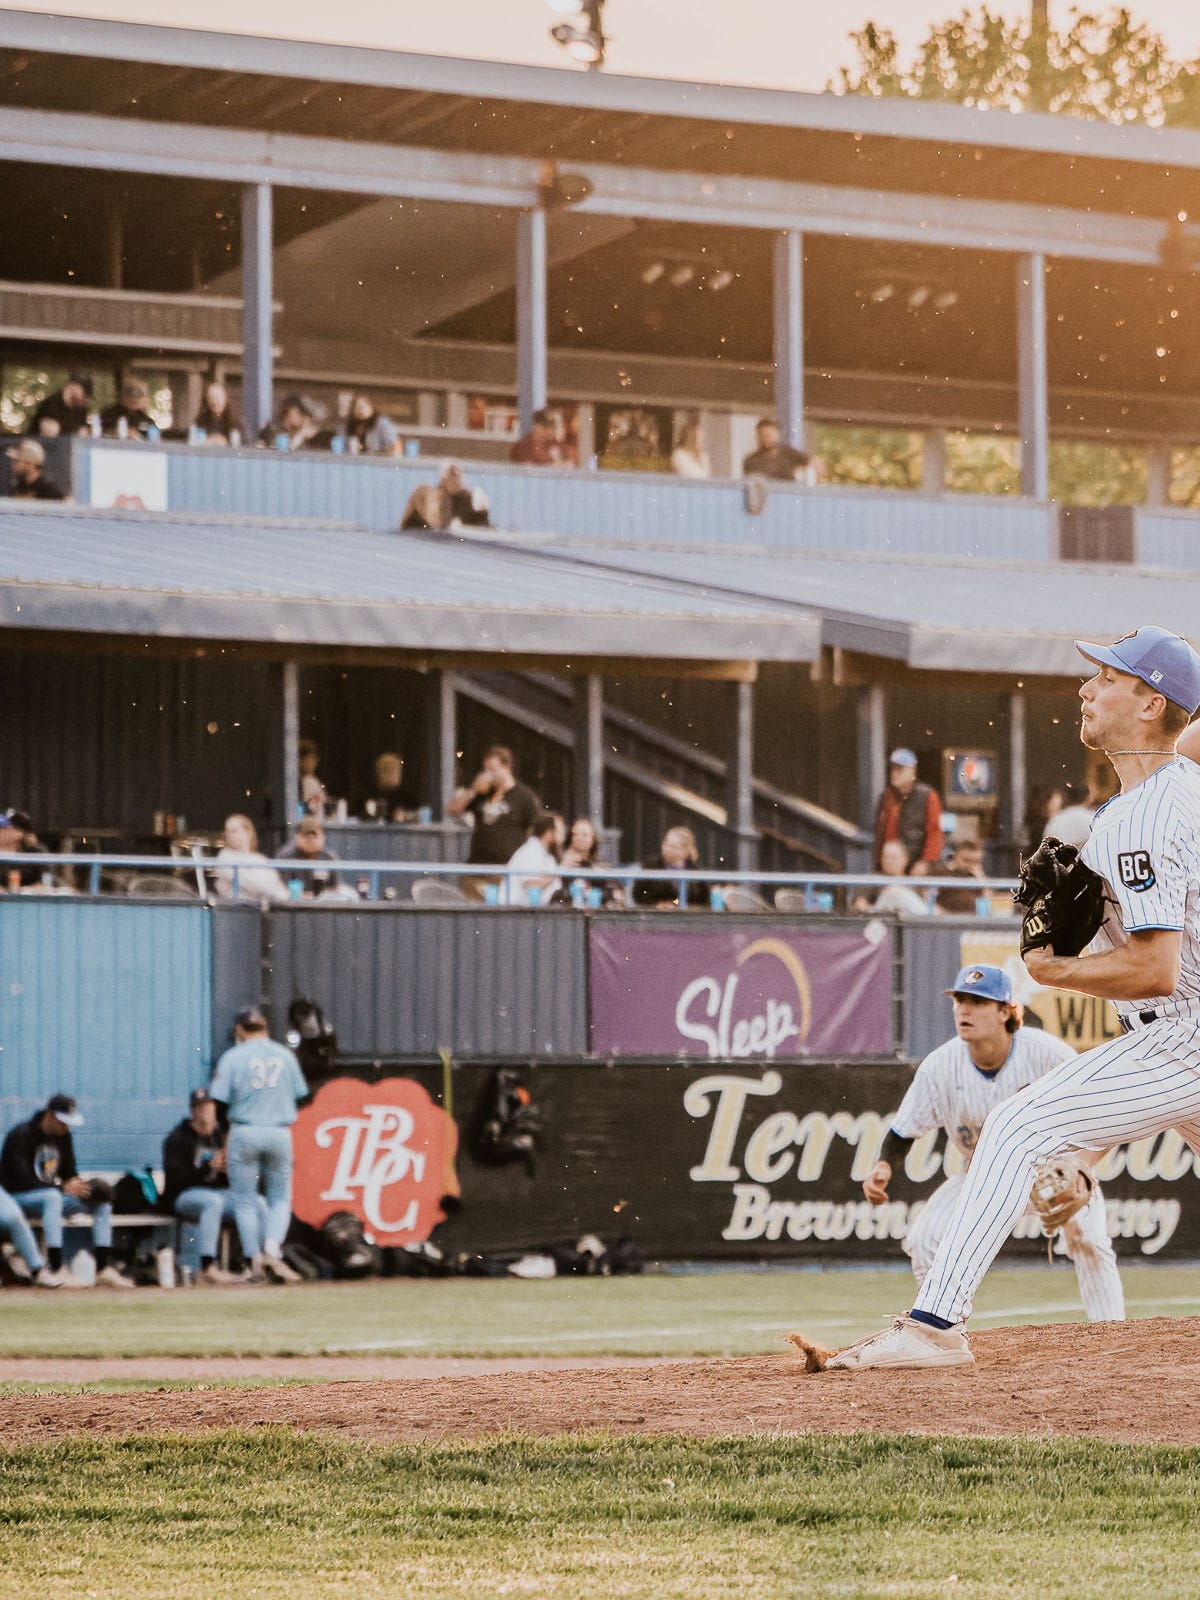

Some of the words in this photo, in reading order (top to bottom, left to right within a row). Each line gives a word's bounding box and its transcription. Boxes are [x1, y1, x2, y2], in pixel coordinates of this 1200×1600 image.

[1120, 853, 1150, 882] BC
[675, 972, 800, 1057] Sleep
[249, 1057, 284, 1089] 37
